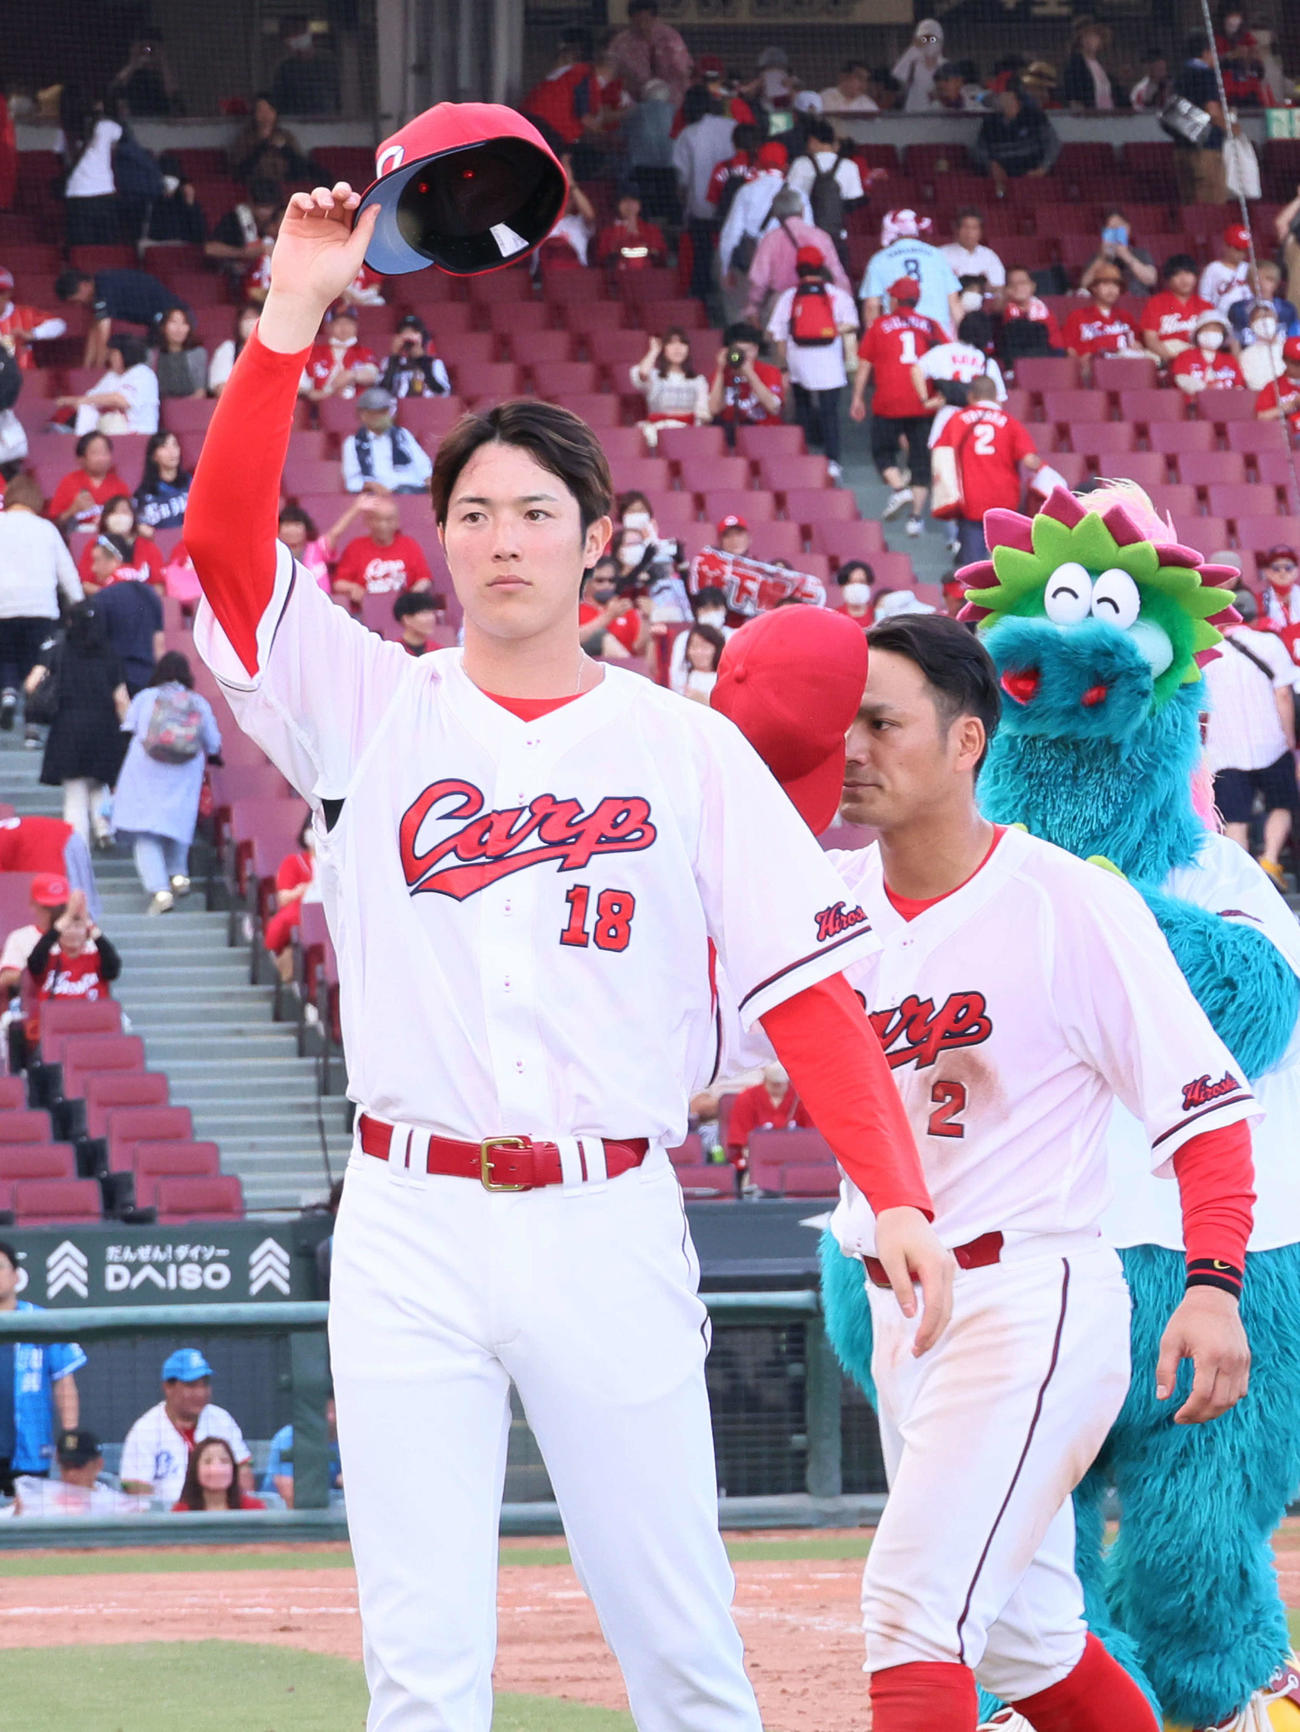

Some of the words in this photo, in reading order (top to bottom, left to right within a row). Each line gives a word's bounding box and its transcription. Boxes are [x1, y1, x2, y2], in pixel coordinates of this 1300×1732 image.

[899, 331, 919, 364] 1
[973, 424, 996, 455] 2
[399, 778, 658, 902] Carp
[560, 884, 636, 952] 18
[927, 1080, 967, 1138] 2
[105, 1263, 231, 1292] DAISO
